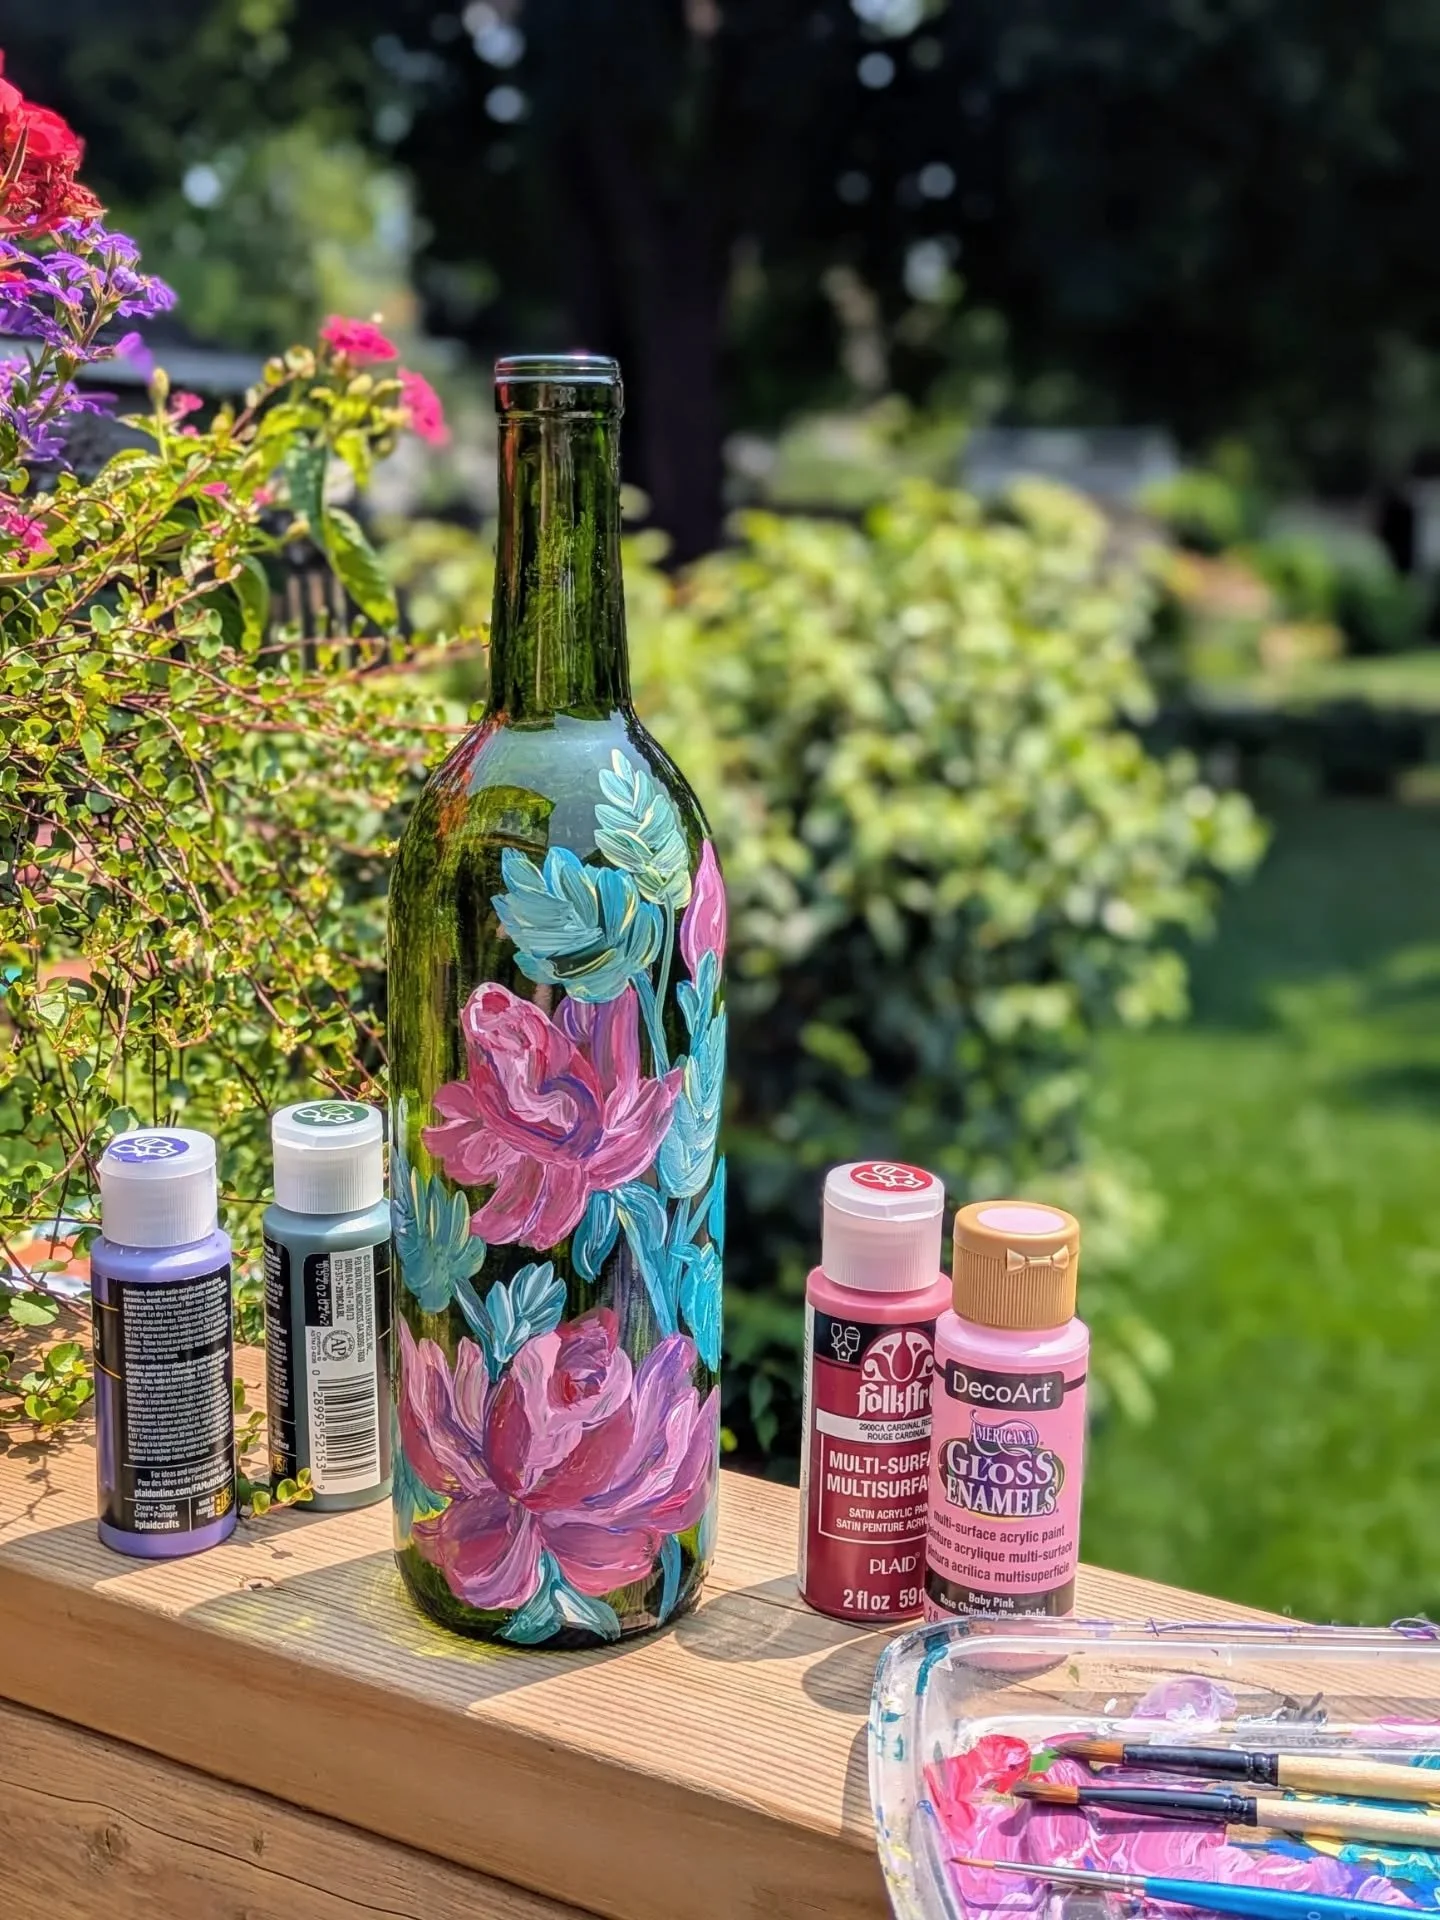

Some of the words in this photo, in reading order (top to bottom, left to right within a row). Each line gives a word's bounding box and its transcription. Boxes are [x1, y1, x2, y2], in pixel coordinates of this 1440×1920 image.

[330, 1338, 346, 1356] AP
[954, 1370, 1051, 1404] DecoArt
[313, 1392, 325, 1427] 28995
[859, 1423, 885, 1432] 2900CA
[887, 1420, 920, 1432] CARDINAL
[895, 1428, 926, 1440] CARDINAL
[969, 1420, 1034, 1445] AMERICANA
[315, 1434, 326, 1470] 52153
[946, 1441, 1055, 1486] GLOSS
[151, 1479, 161, 1487] des
[161, 1470, 176, 1478] ideas
[946, 1474, 1056, 1516] ENAMELS
[136, 1503, 154, 1511] Create
[160, 1503, 176, 1511] Share
[849, 1508, 874, 1519] SATIN
[876, 1506, 912, 1520] ACRYLIC
[836, 1518, 860, 1530] SATIN
[863, 1522, 904, 1532] PEINTURE
[934, 1510, 996, 1541] multi-surface
[1000, 1529, 1039, 1546] acrylic
[1042, 1525, 1065, 1544] paint
[954, 1542, 1006, 1562] acrylique
[1008, 1541, 1072, 1562] multi-surface
[994, 1562, 1070, 1584] multisuperficie
[843, 1589, 854, 1608] 2
[857, 1590, 868, 1610] fl
[871, 1595, 890, 1610] oz
[940, 1592, 956, 1609] Rose
[968, 1592, 991, 1608] Baby
[994, 1597, 1014, 1609] Pink
